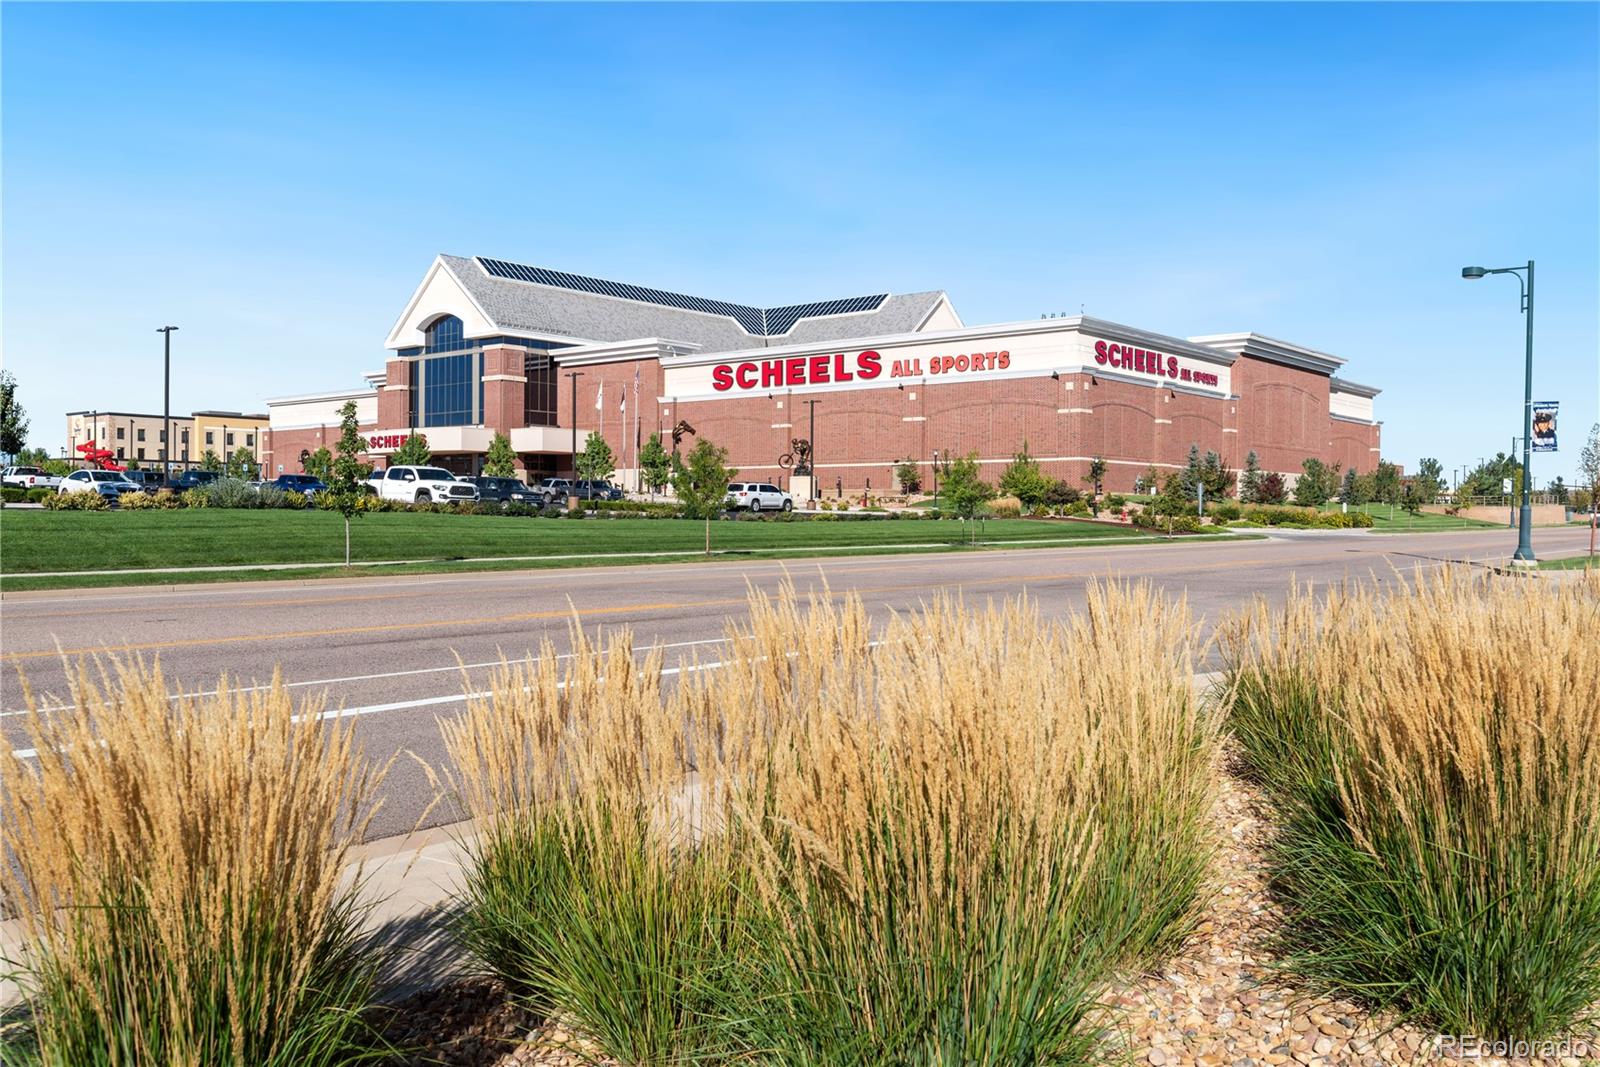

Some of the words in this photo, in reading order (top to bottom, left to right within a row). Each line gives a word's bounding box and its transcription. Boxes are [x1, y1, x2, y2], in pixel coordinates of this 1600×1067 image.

[712, 350, 882, 391] SCHEELS
[890, 358, 923, 378] ALL
[929, 351, 1011, 375] SPORTS
[1095, 340, 1179, 379] SCHEELS
